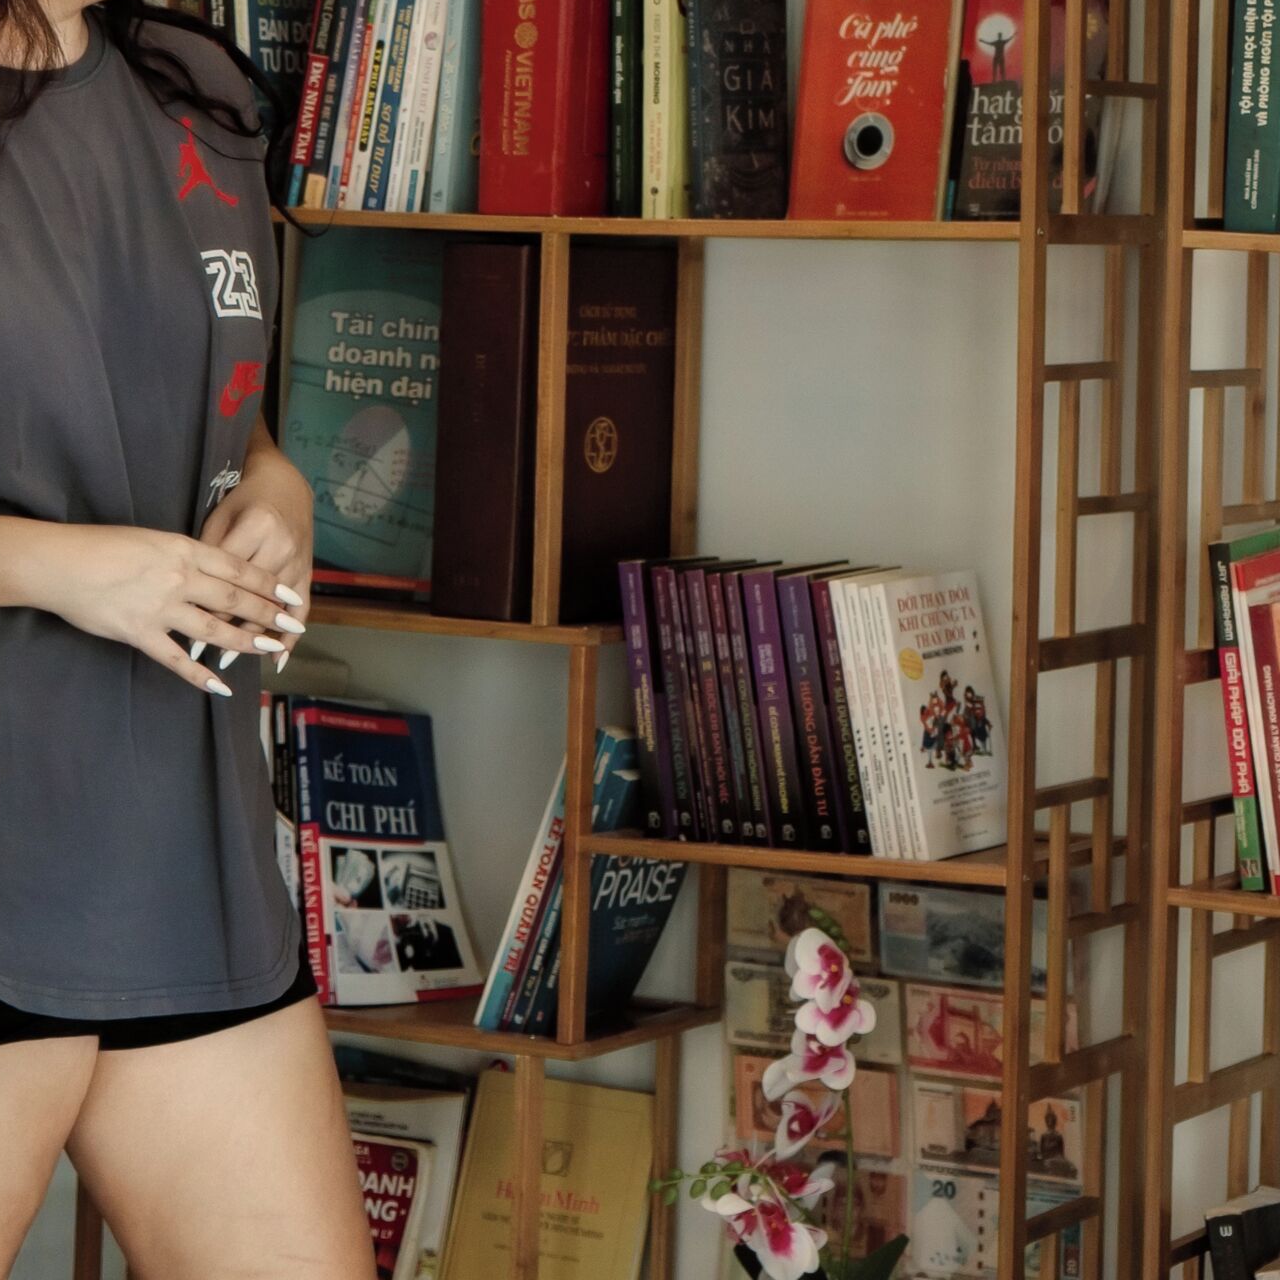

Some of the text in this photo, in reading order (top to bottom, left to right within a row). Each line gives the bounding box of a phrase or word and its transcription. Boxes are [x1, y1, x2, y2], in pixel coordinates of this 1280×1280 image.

[838, 13, 874, 40] Cà
[1260, 9, 1277, 28] TỘI
[1243, 36, 1259, 60] HỌC
[652, 61, 661, 105] MORNING
[1241, 61, 1257, 94] PHẠM
[1257, 67, 1272, 109] PHÒNG
[512, 51, 536, 157] VIETNAM
[970, 87, 1012, 120] hạt
[1238, 95, 1255, 115] TỘI
[1256, 110, 1270, 127] VÀ
[967, 119, 1023, 146] tâm
[369, 164, 384, 193] DUY
[200, 249, 263, 320] 23
[331, 308, 440, 341] Tài chín
[328, 341, 411, 370] doanh
[325, 370, 432, 405] hiện đại
[959, 606, 977, 620] TA
[323, 752, 398, 787] KẾ TOÁN
[326, 798, 419, 836] CHI PHÍ
[302, 860, 321, 908] TOÁN
[593, 862, 683, 910] PRAISE
[305, 911, 323, 943] CHI
[932, 1178, 957, 1200] 20
